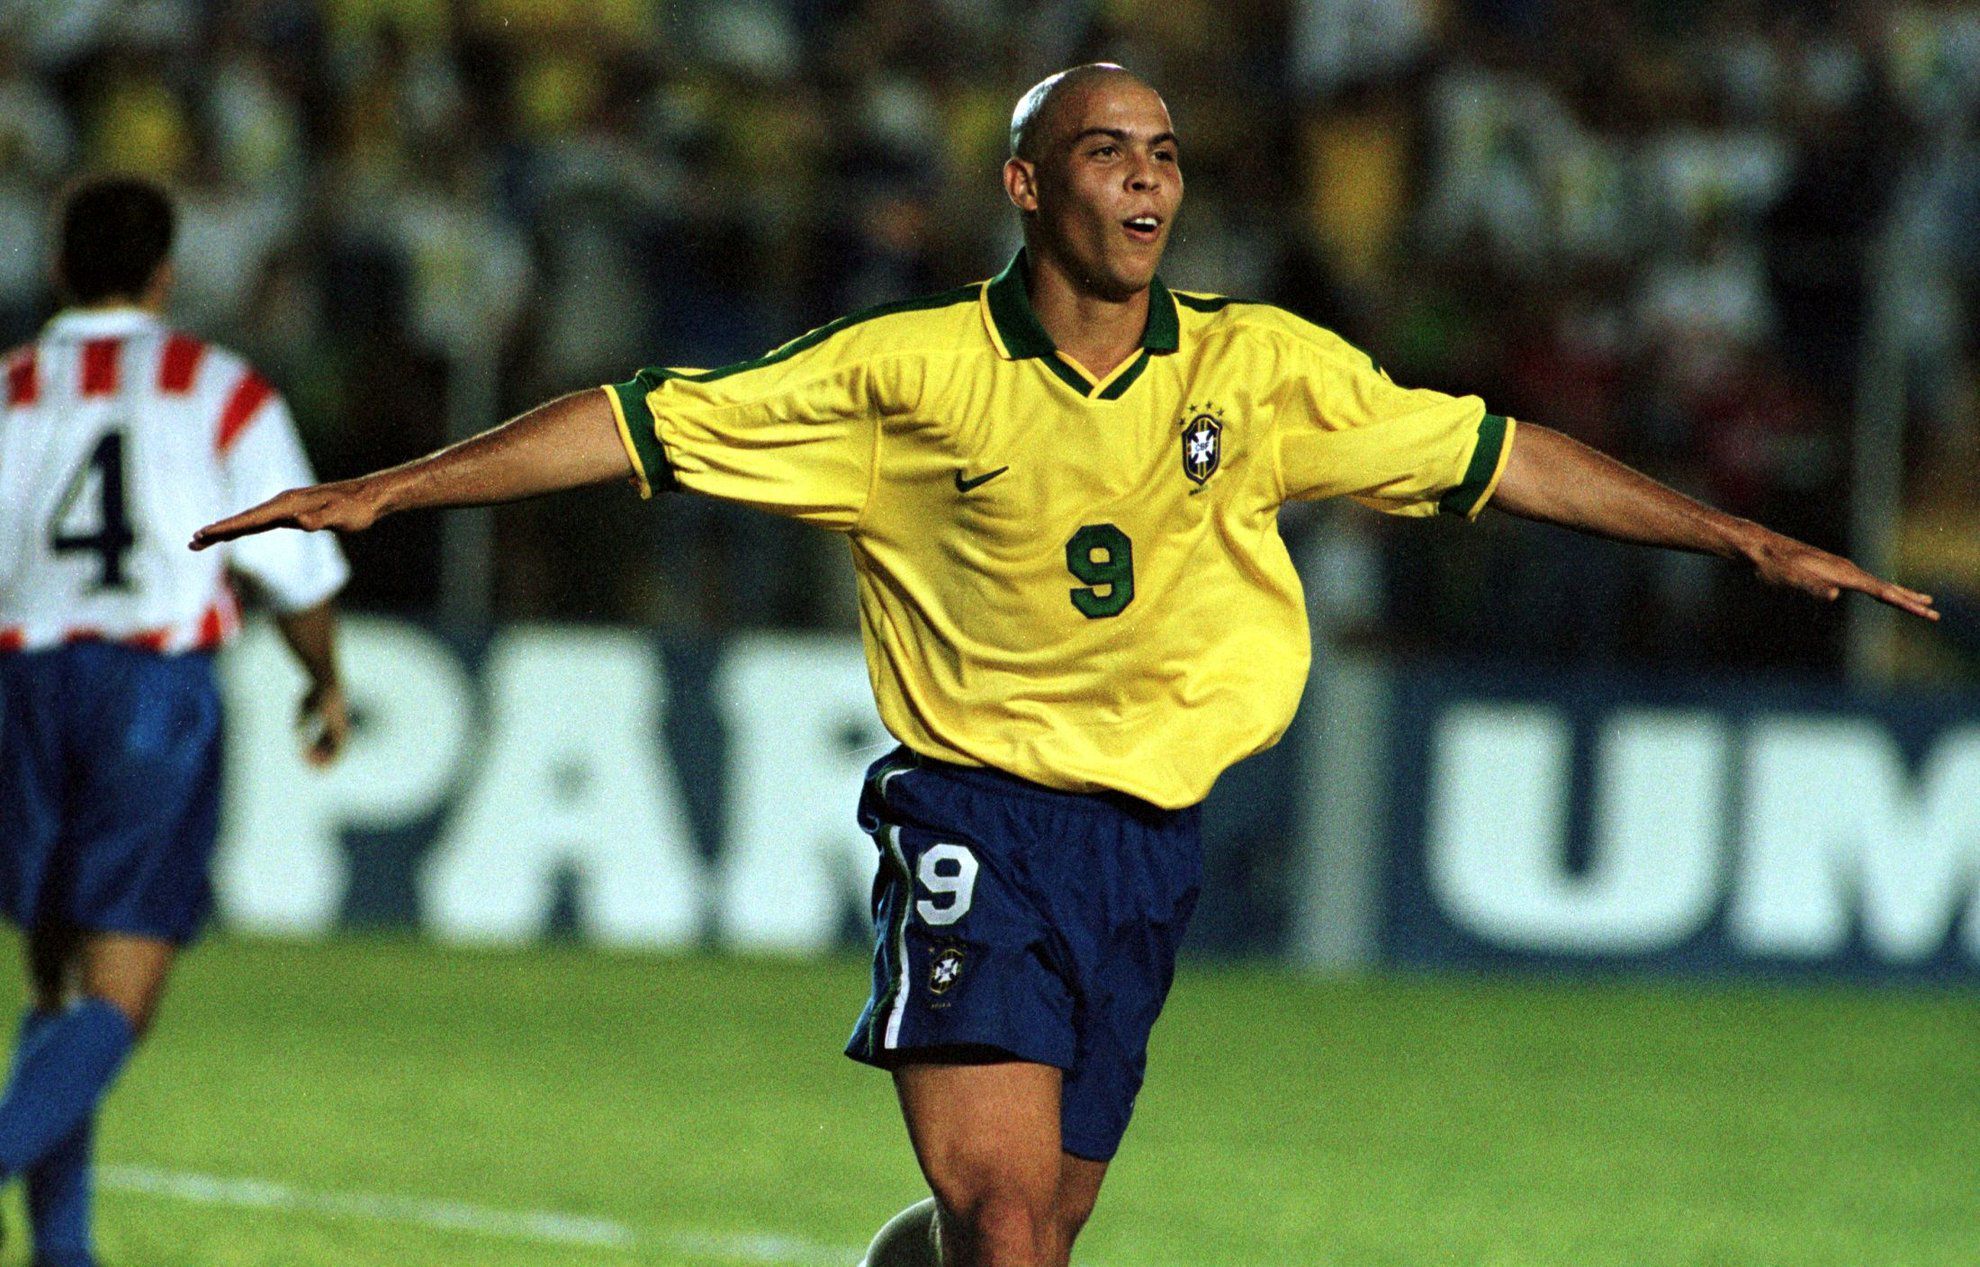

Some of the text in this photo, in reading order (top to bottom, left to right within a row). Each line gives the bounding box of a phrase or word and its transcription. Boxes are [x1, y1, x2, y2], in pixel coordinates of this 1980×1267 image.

[1195, 442, 1210, 452] CBF
[49, 427, 134, 592] 4
[1065, 523, 1135, 619] 9
[917, 843, 979, 926] 9
